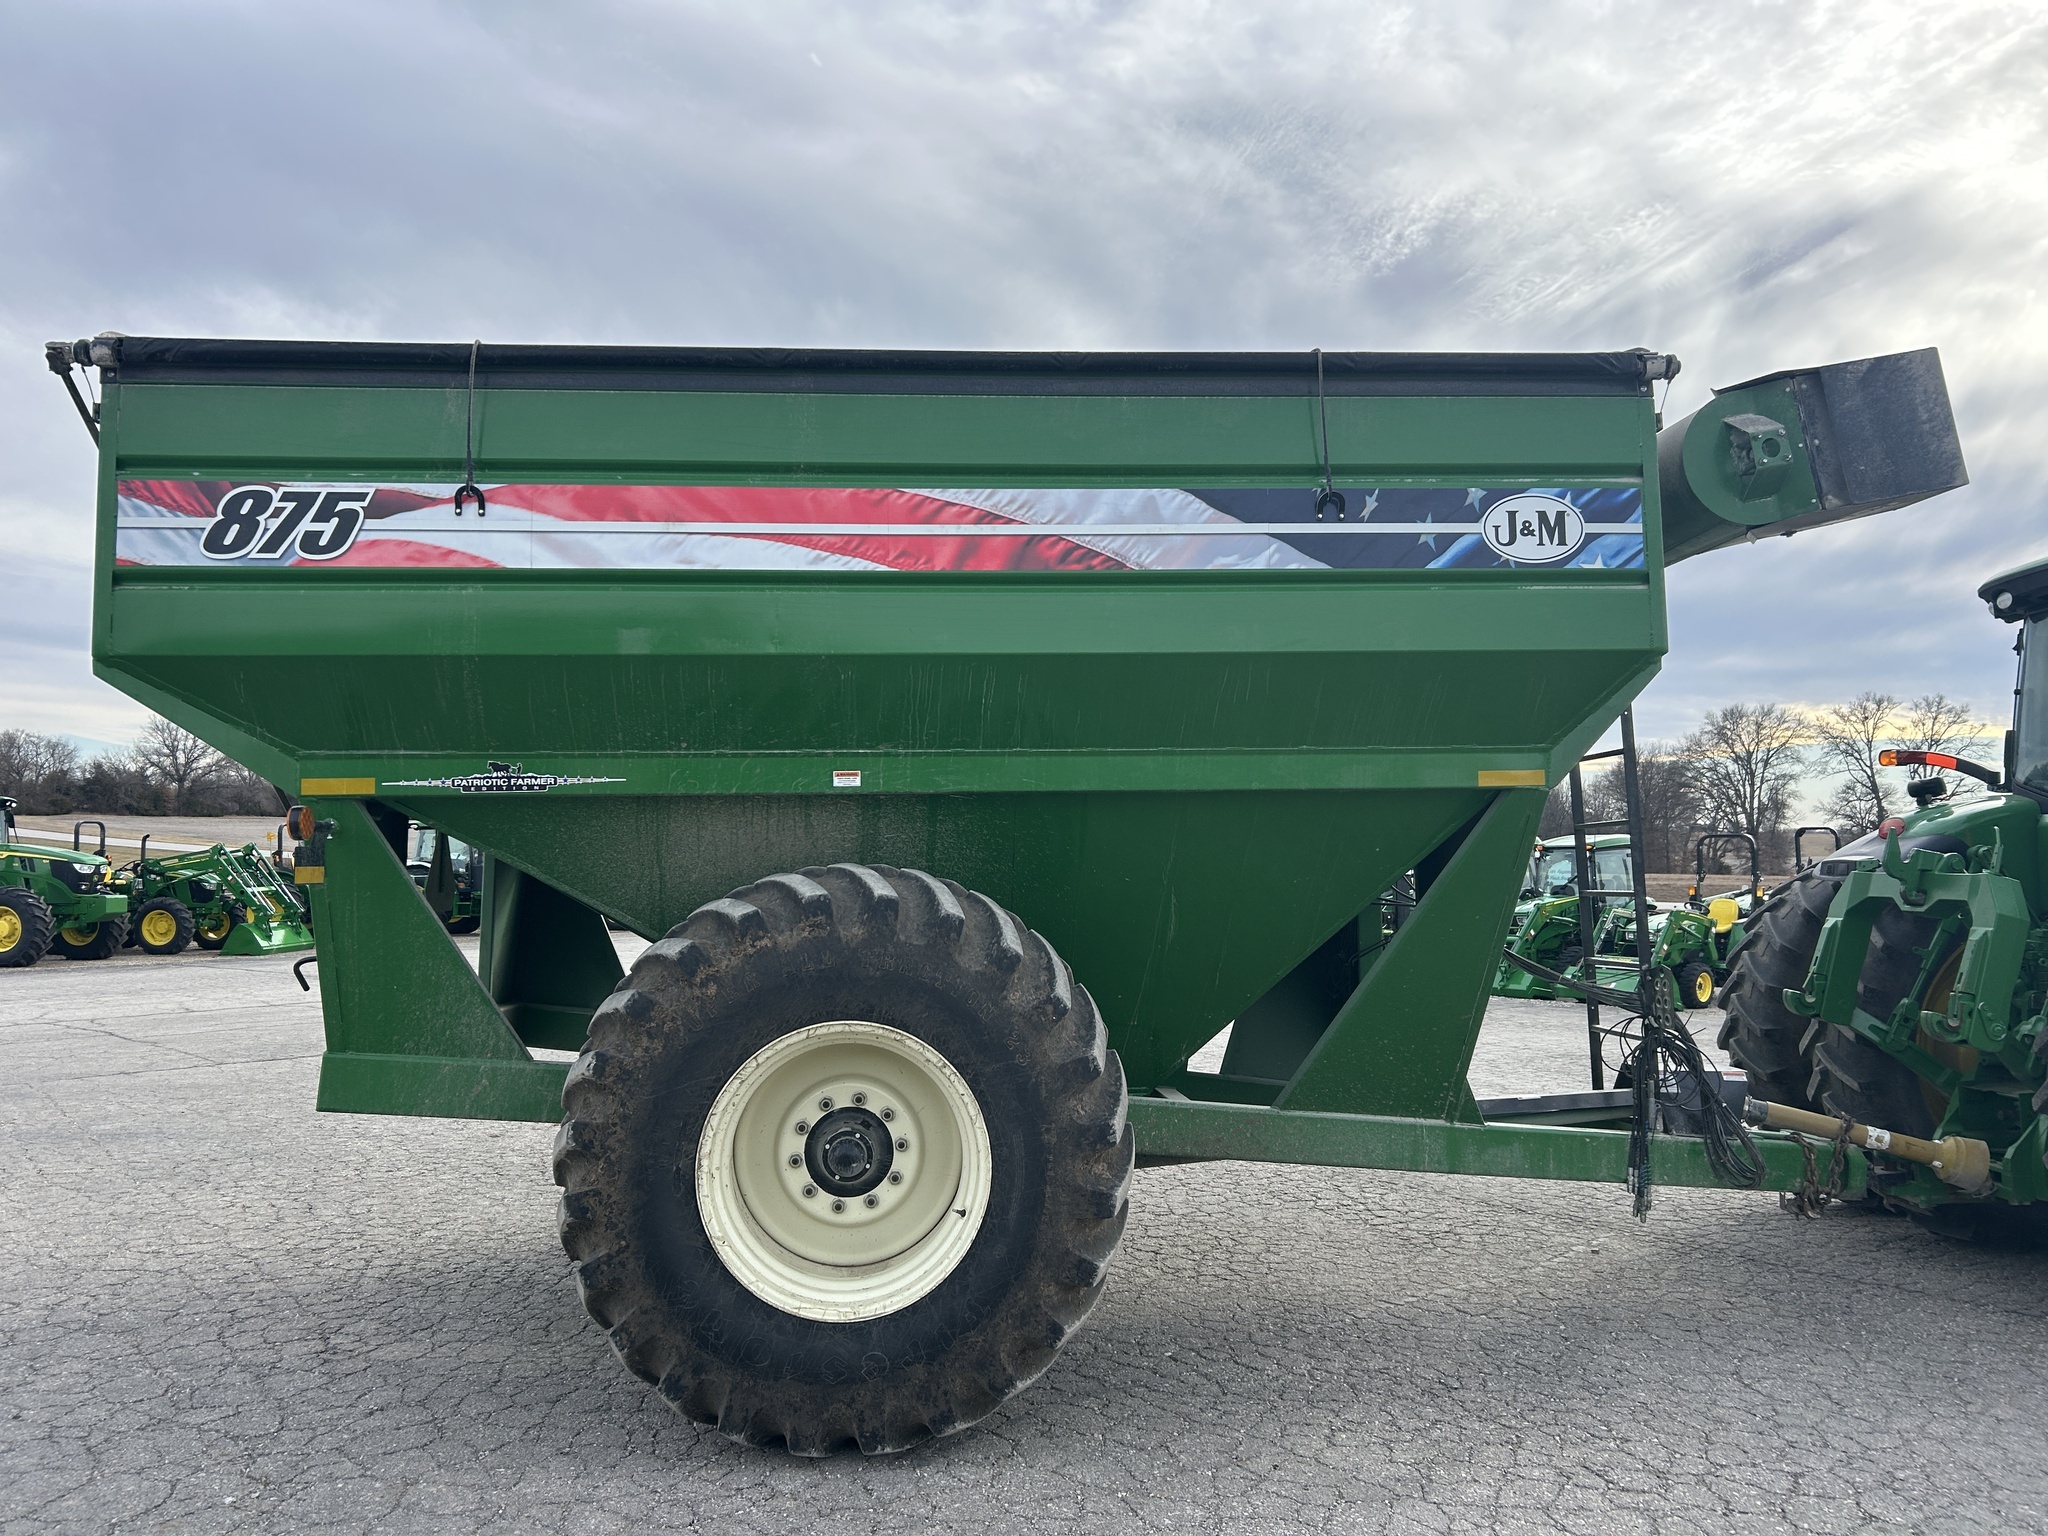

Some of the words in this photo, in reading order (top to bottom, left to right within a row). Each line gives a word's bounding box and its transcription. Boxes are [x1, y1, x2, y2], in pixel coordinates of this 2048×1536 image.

[200, 485, 375, 560] 875
[1492, 510, 1569, 547] J&M
[453, 778, 509, 787] PATRIOTIC
[511, 777, 555, 786] FARMER
